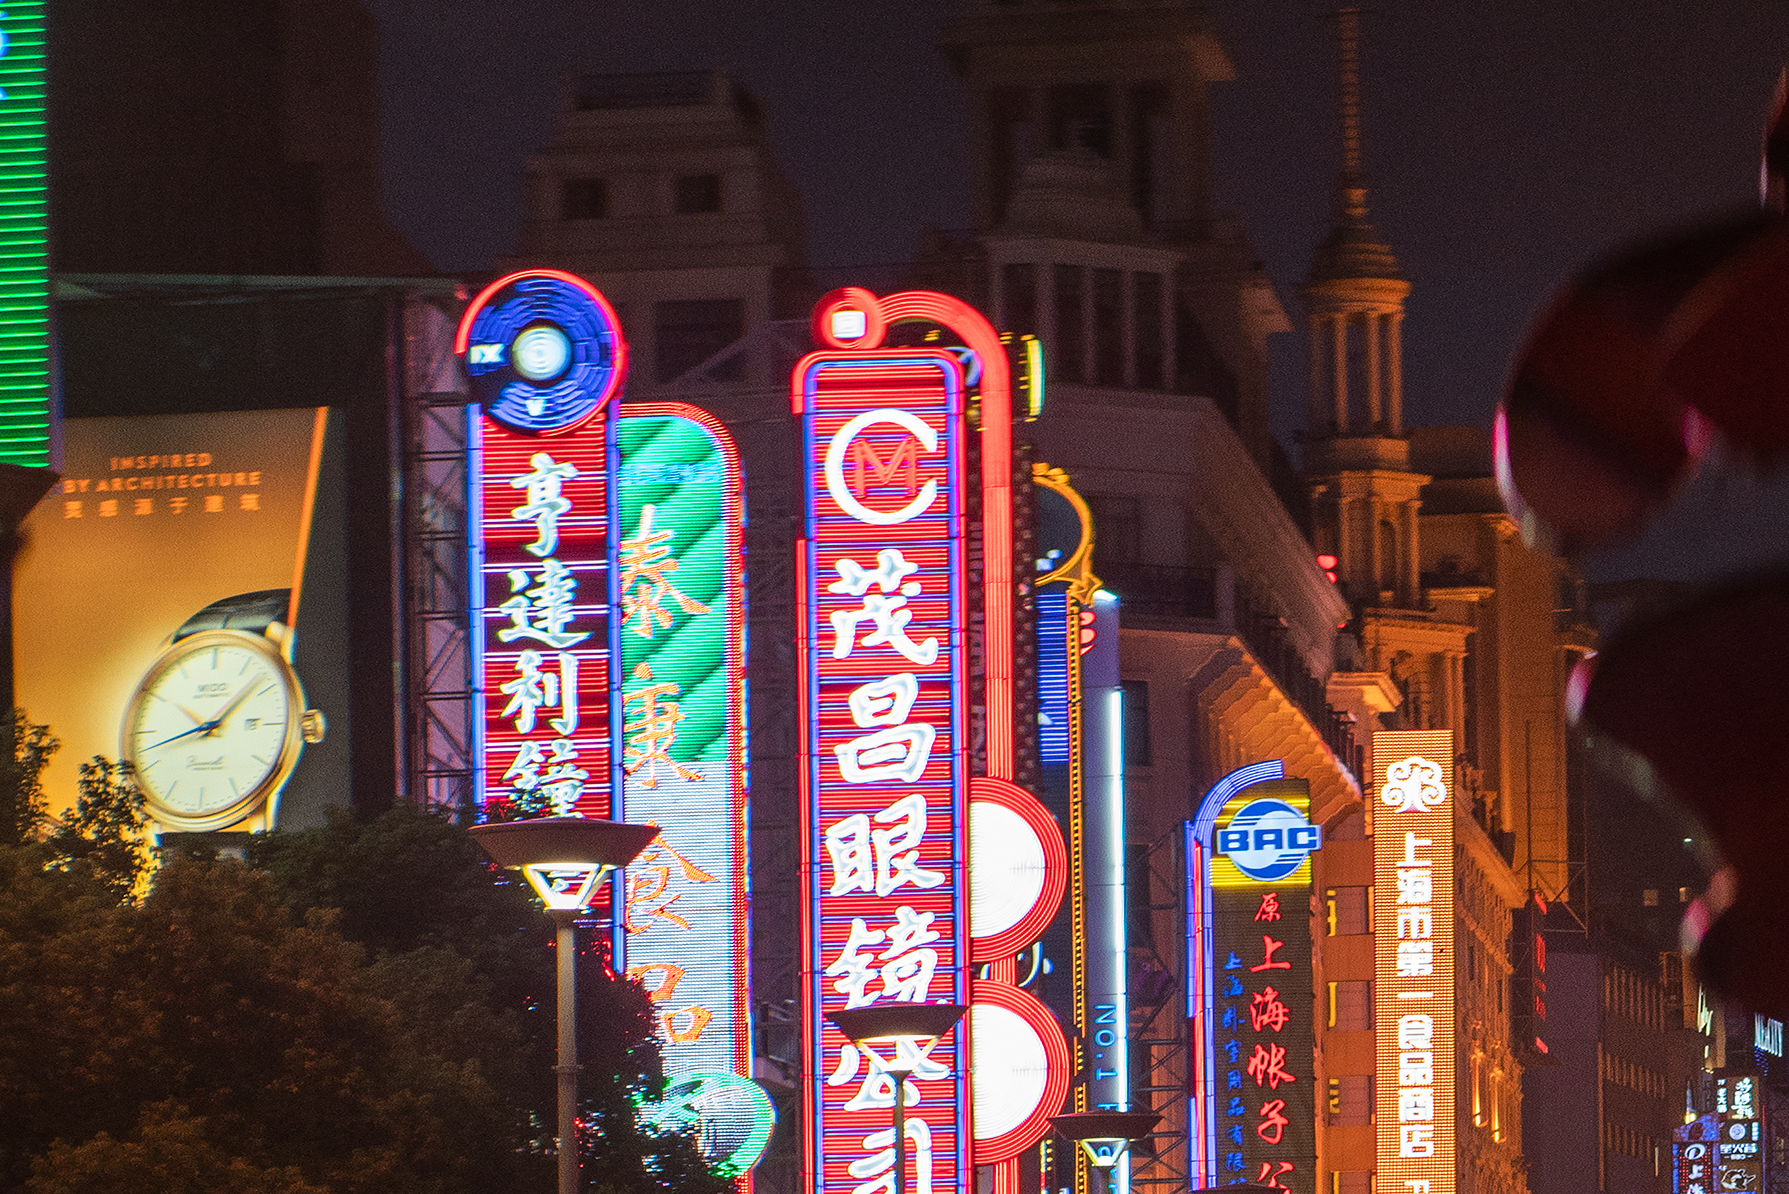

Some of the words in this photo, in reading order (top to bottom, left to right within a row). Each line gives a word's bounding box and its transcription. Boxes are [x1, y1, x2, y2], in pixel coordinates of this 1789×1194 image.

[111, 452, 212, 471] INSPIRED
[63, 479, 90, 494] BY
[96, 471, 261, 492] ARCHITECTURE
[1220, 827, 1320, 853] BAC
[1396, 831, 1435, 1159] 上海市第一食品商店
